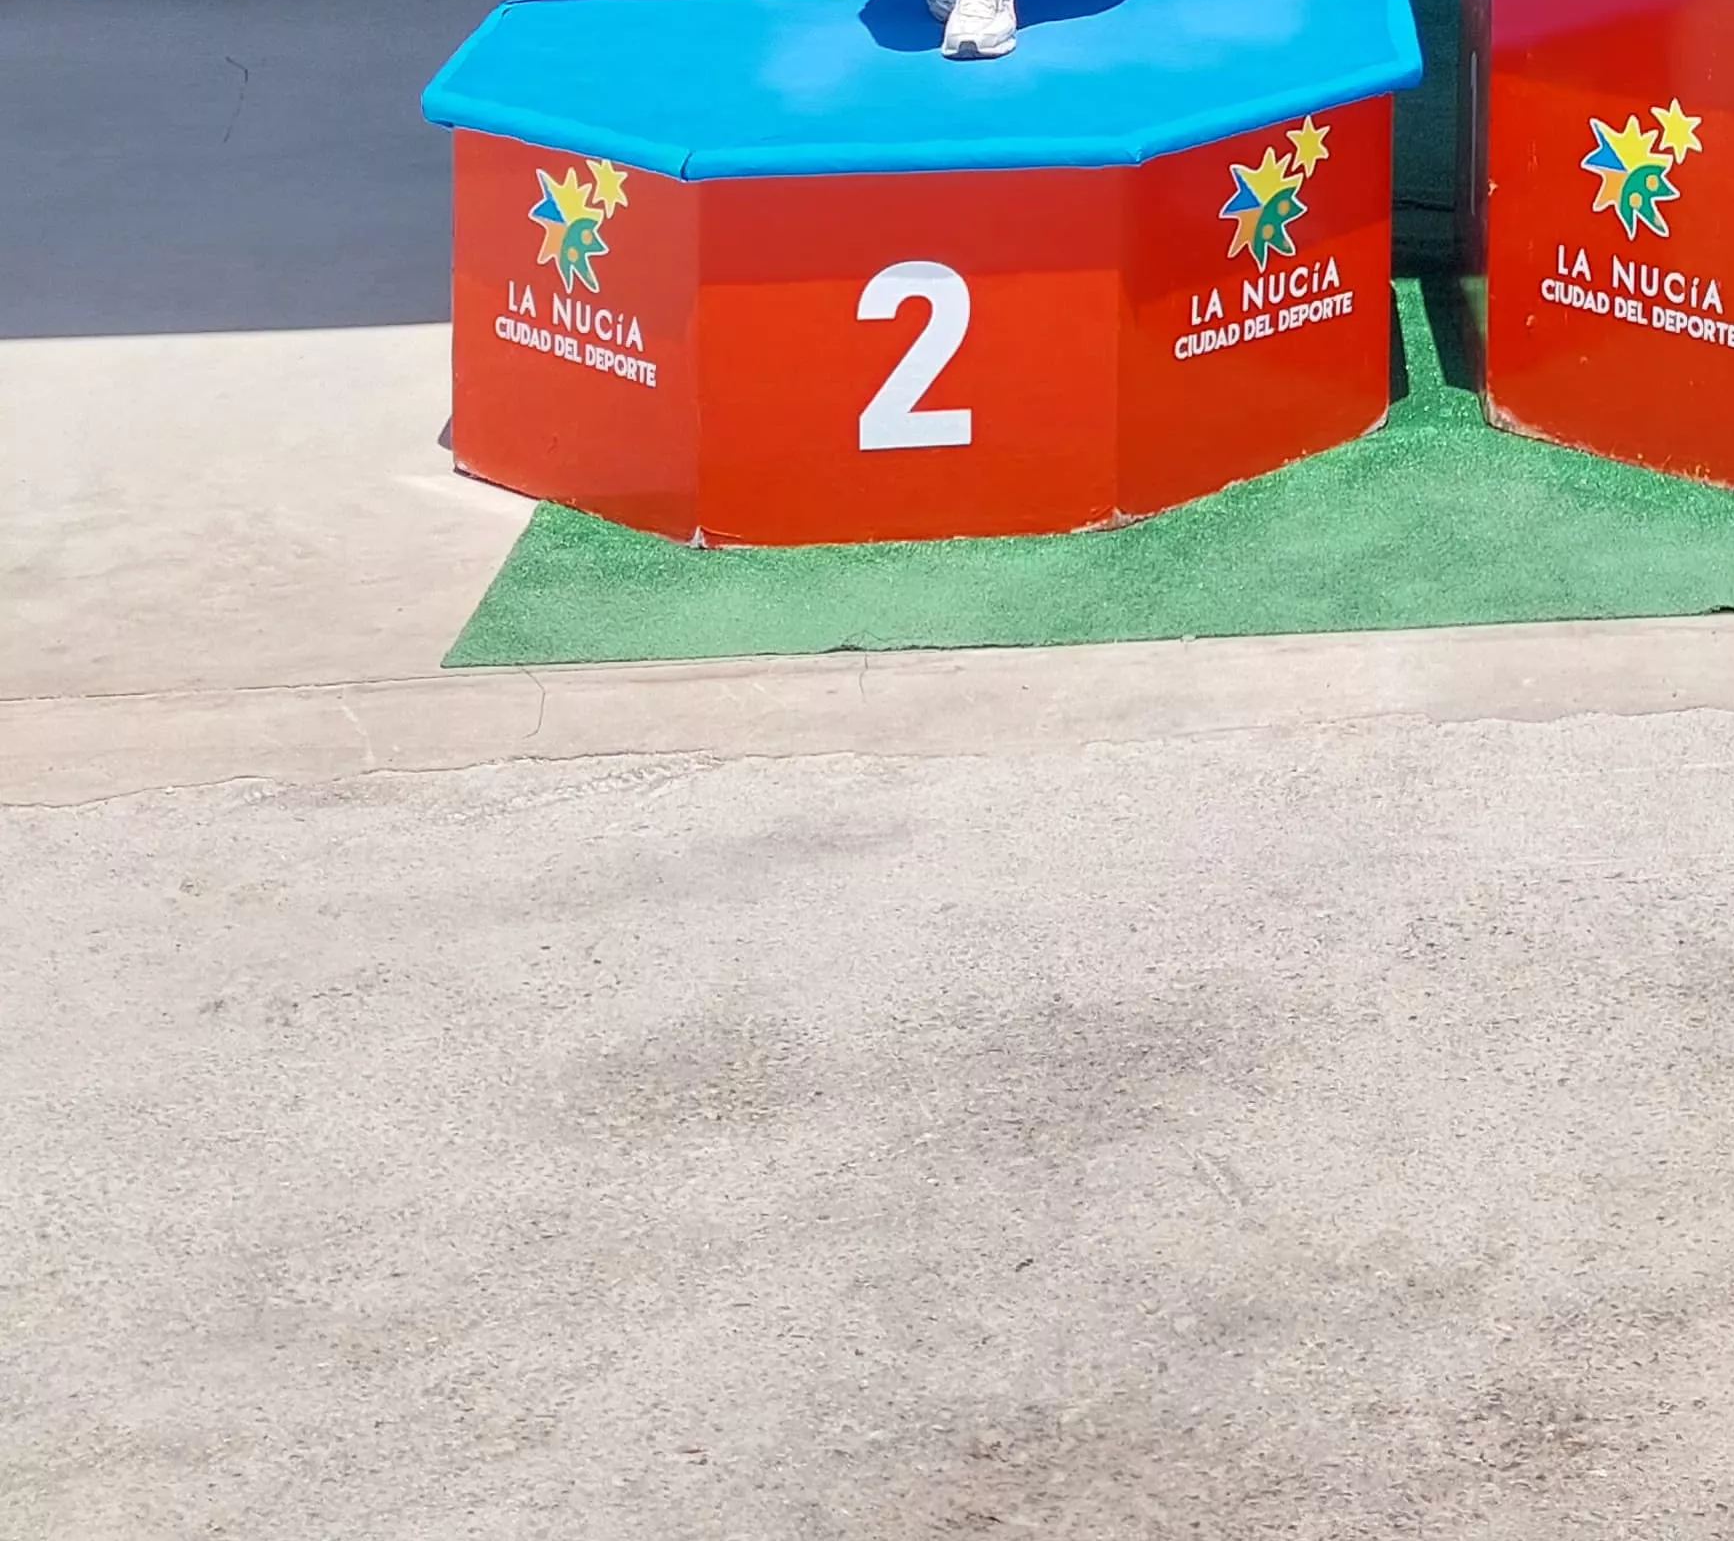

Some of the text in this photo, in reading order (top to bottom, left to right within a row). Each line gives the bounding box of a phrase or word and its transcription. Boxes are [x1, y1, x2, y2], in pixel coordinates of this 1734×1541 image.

[1557, 244, 1592, 282] LA
[508, 280, 537, 318] LA
[1191, 288, 1224, 325] LA
[1541, 278, 1610, 314] CIUDAD
[1614, 296, 1648, 325] DEL
[1174, 291, 1353, 360] CIUDAD DEL DEPORTE
[495, 316, 657, 387] CIUDAD DEL DEPORTE
[857, 261, 972, 451] 2
